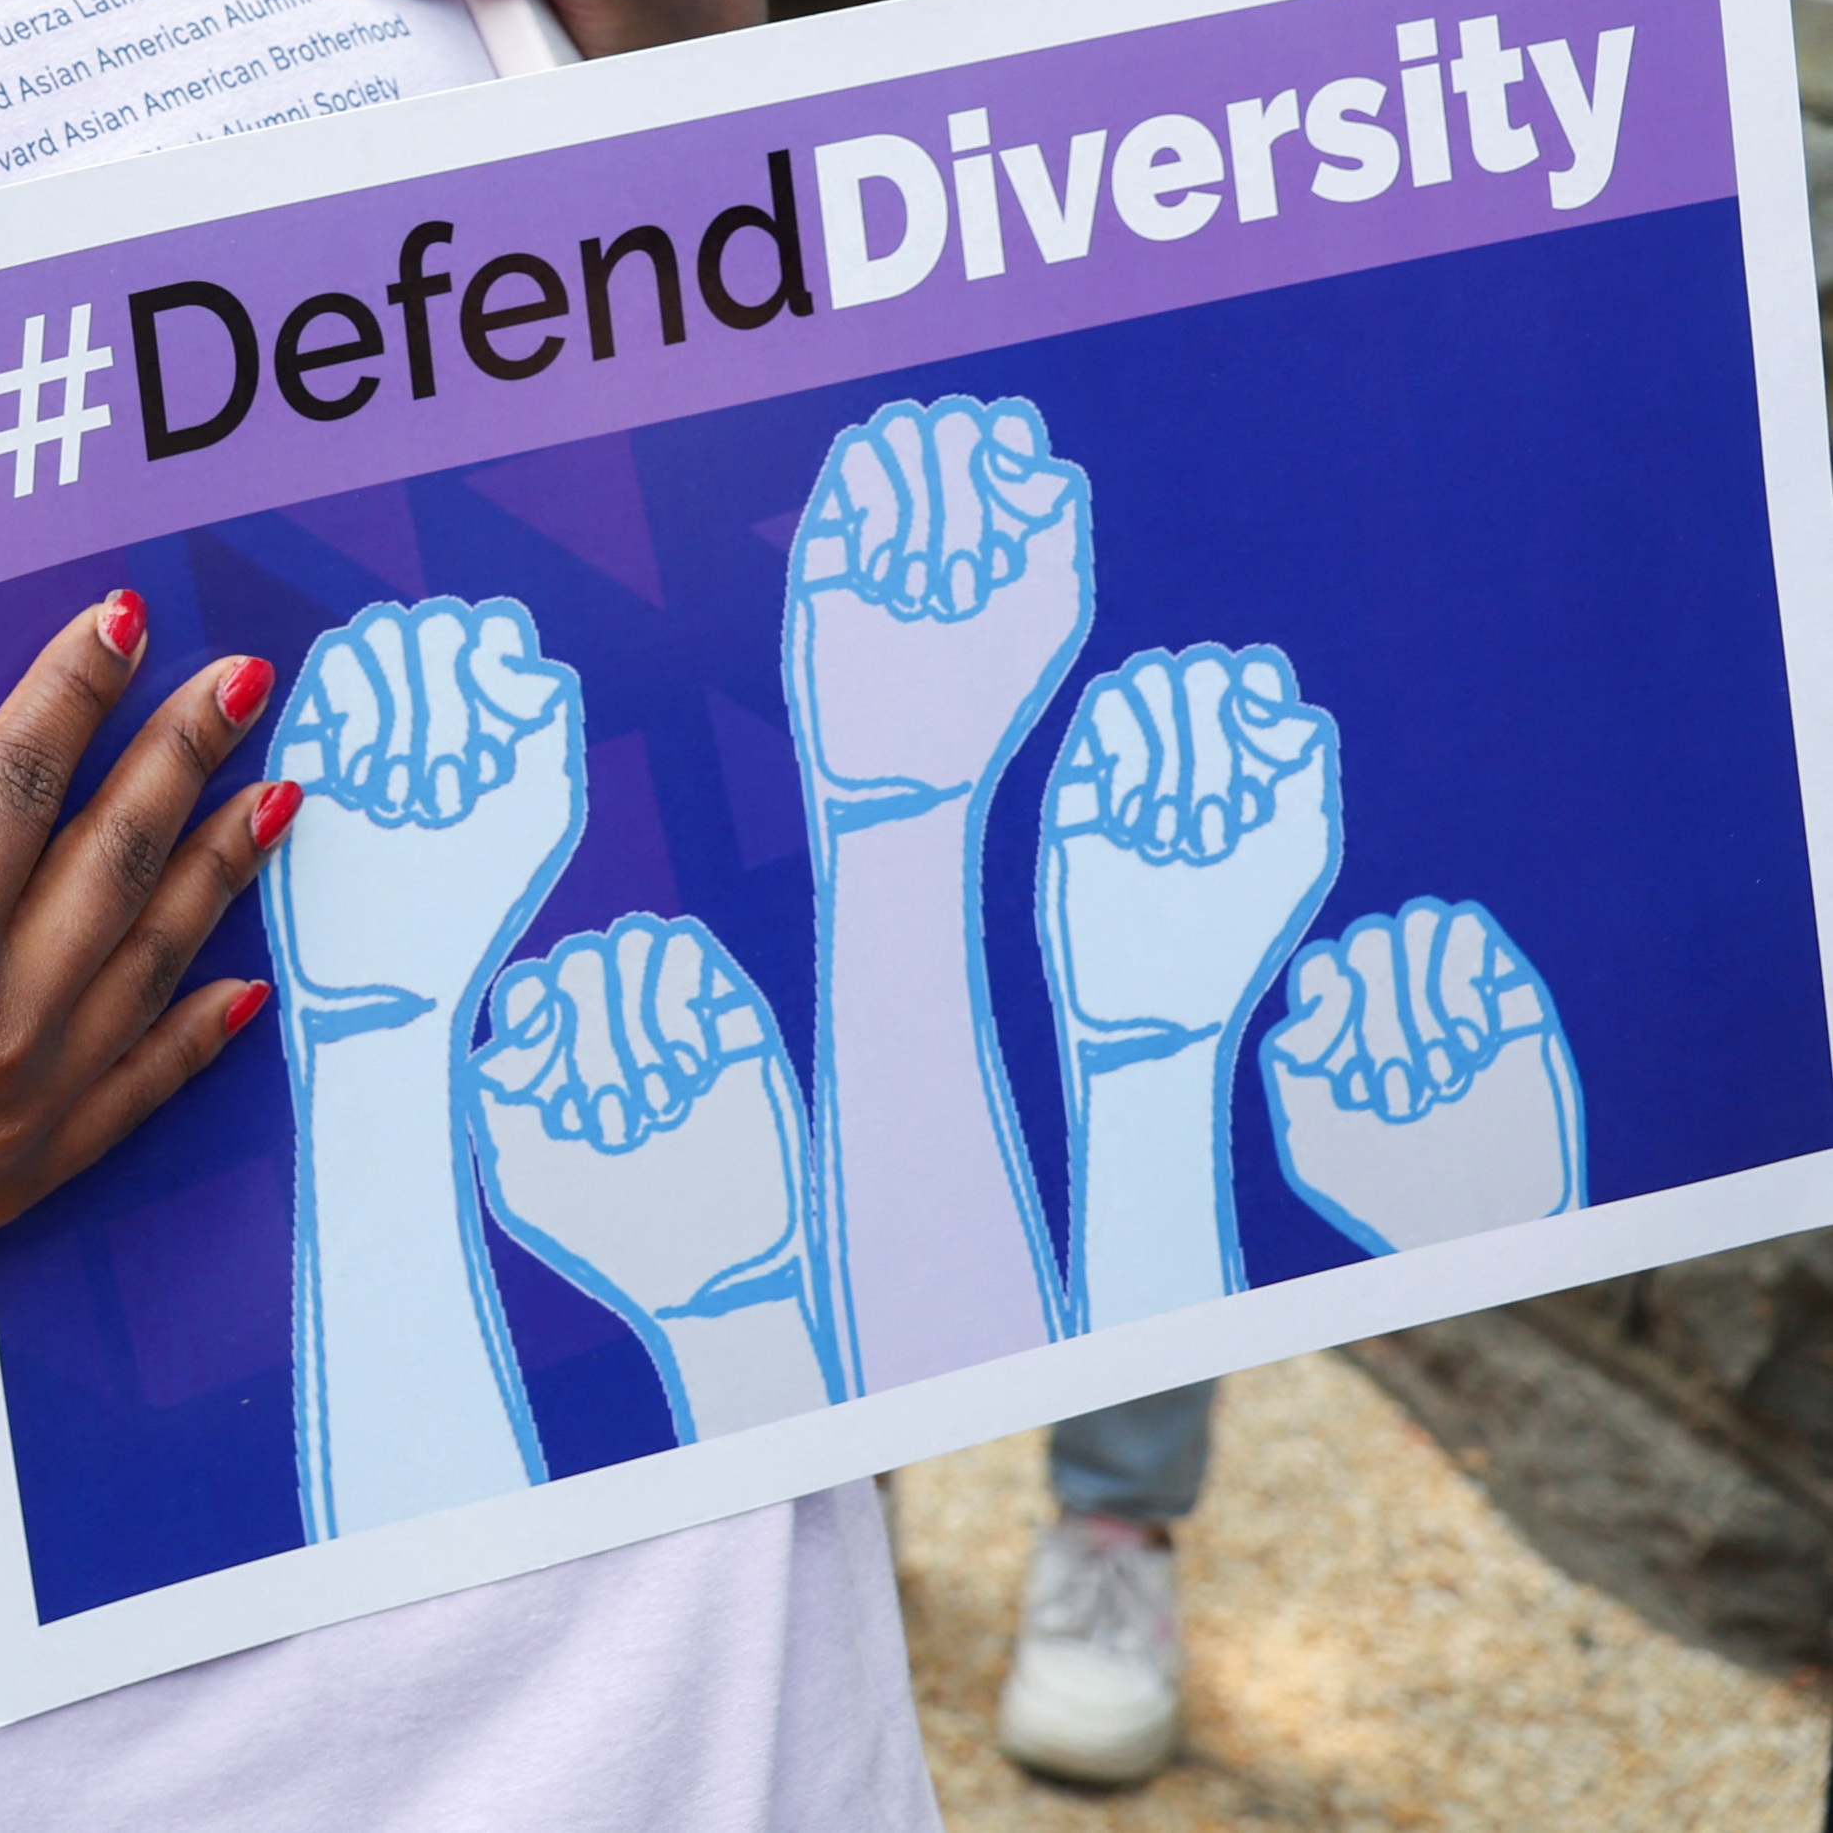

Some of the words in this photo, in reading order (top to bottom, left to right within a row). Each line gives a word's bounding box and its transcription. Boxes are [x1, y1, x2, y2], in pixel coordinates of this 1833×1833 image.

[18, 59, 93, 102] Asian
[96, 15, 222, 74] American
[63, 104, 140, 149] Asian
[143, 57, 269, 118] American
[268, 13, 412, 72] Brotherhood
[313, 75, 401, 116] Society
